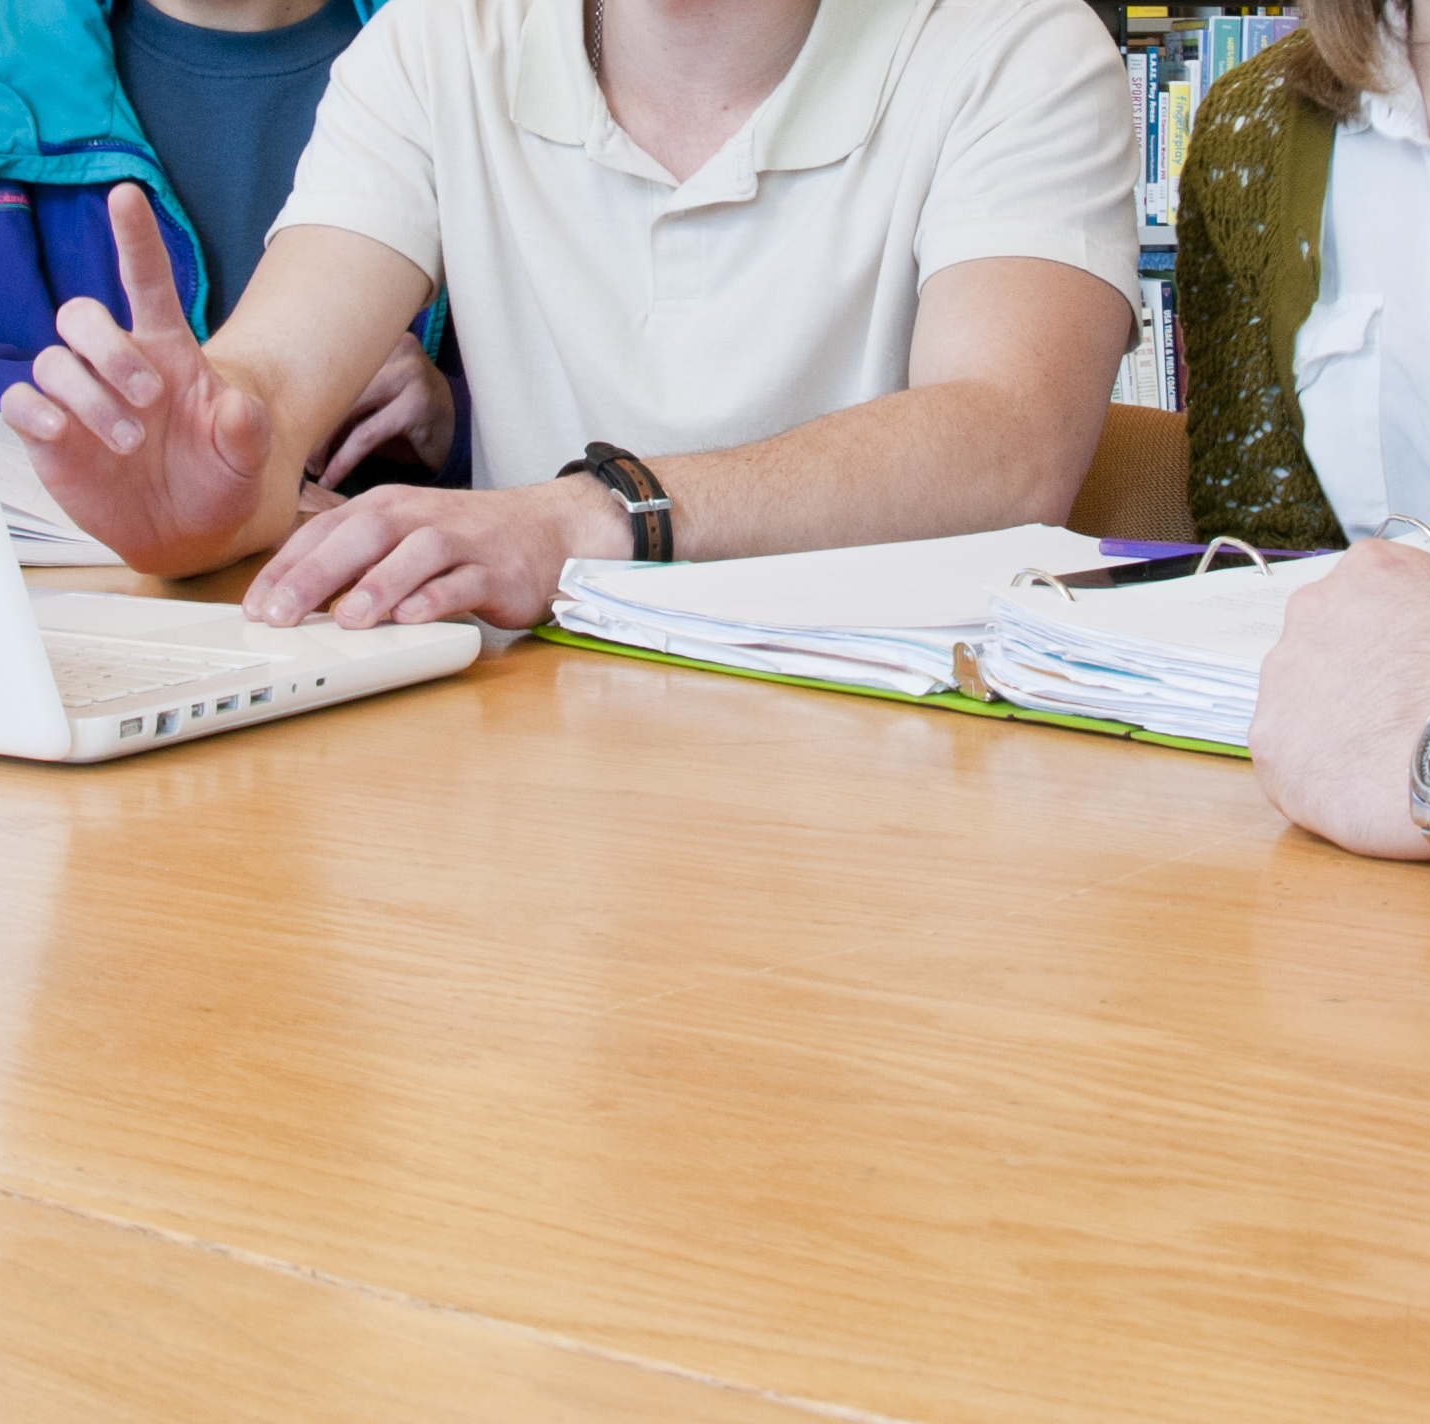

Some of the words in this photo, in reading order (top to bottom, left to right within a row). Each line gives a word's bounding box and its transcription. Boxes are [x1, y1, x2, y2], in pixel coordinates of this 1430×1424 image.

[1131, 77, 1142, 113] SPORTS
[1148, 83, 1156, 98] Play
[1163, 310, 1171, 324] USA
[1164, 325, 1173, 347] TRACK
